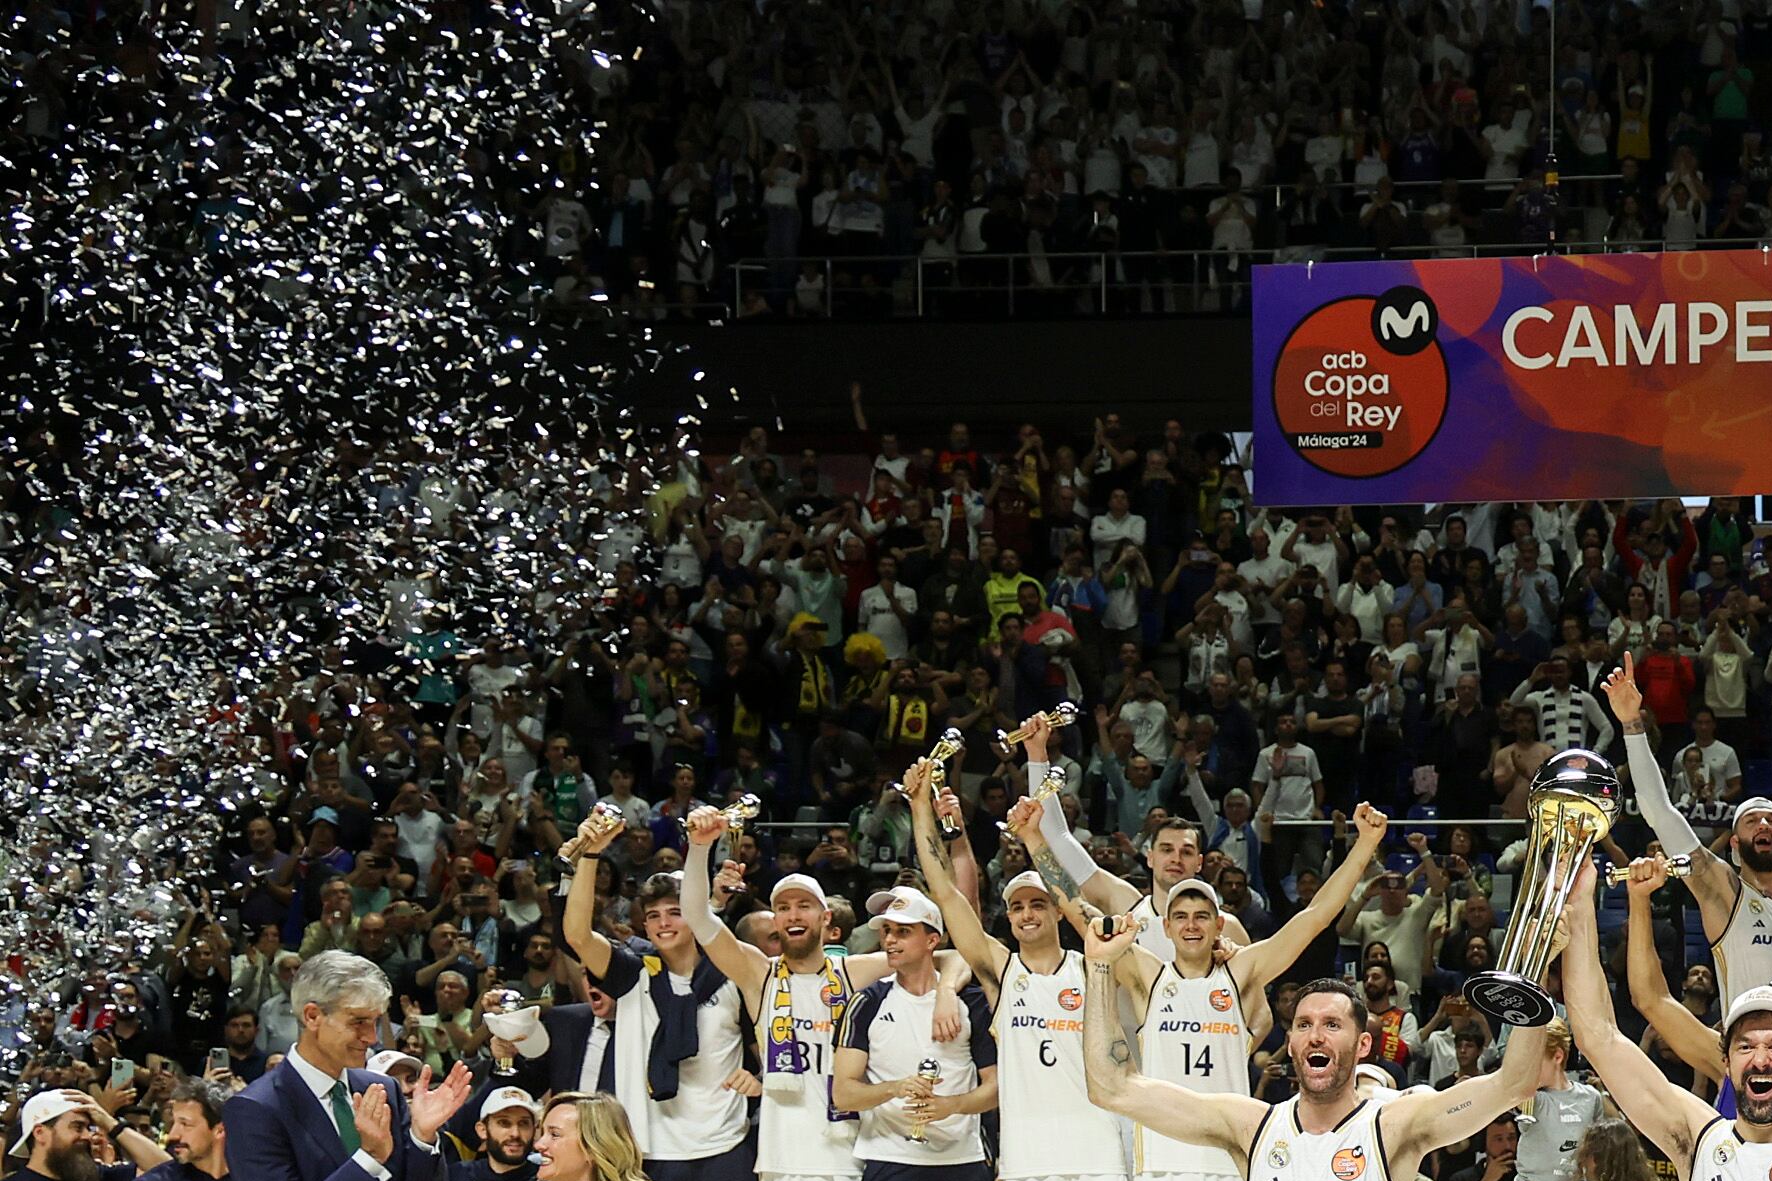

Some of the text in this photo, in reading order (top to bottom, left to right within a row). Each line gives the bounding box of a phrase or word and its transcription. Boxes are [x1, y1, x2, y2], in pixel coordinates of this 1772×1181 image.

[1322, 349, 1366, 370] acb
[1304, 370, 1390, 399] Copa
[1310, 400, 1401, 431] del Rey
[1159, 1021, 1239, 1035] AUTOHERO
[1040, 1040, 1057, 1067] 6
[1181, 1043, 1214, 1077] 14
